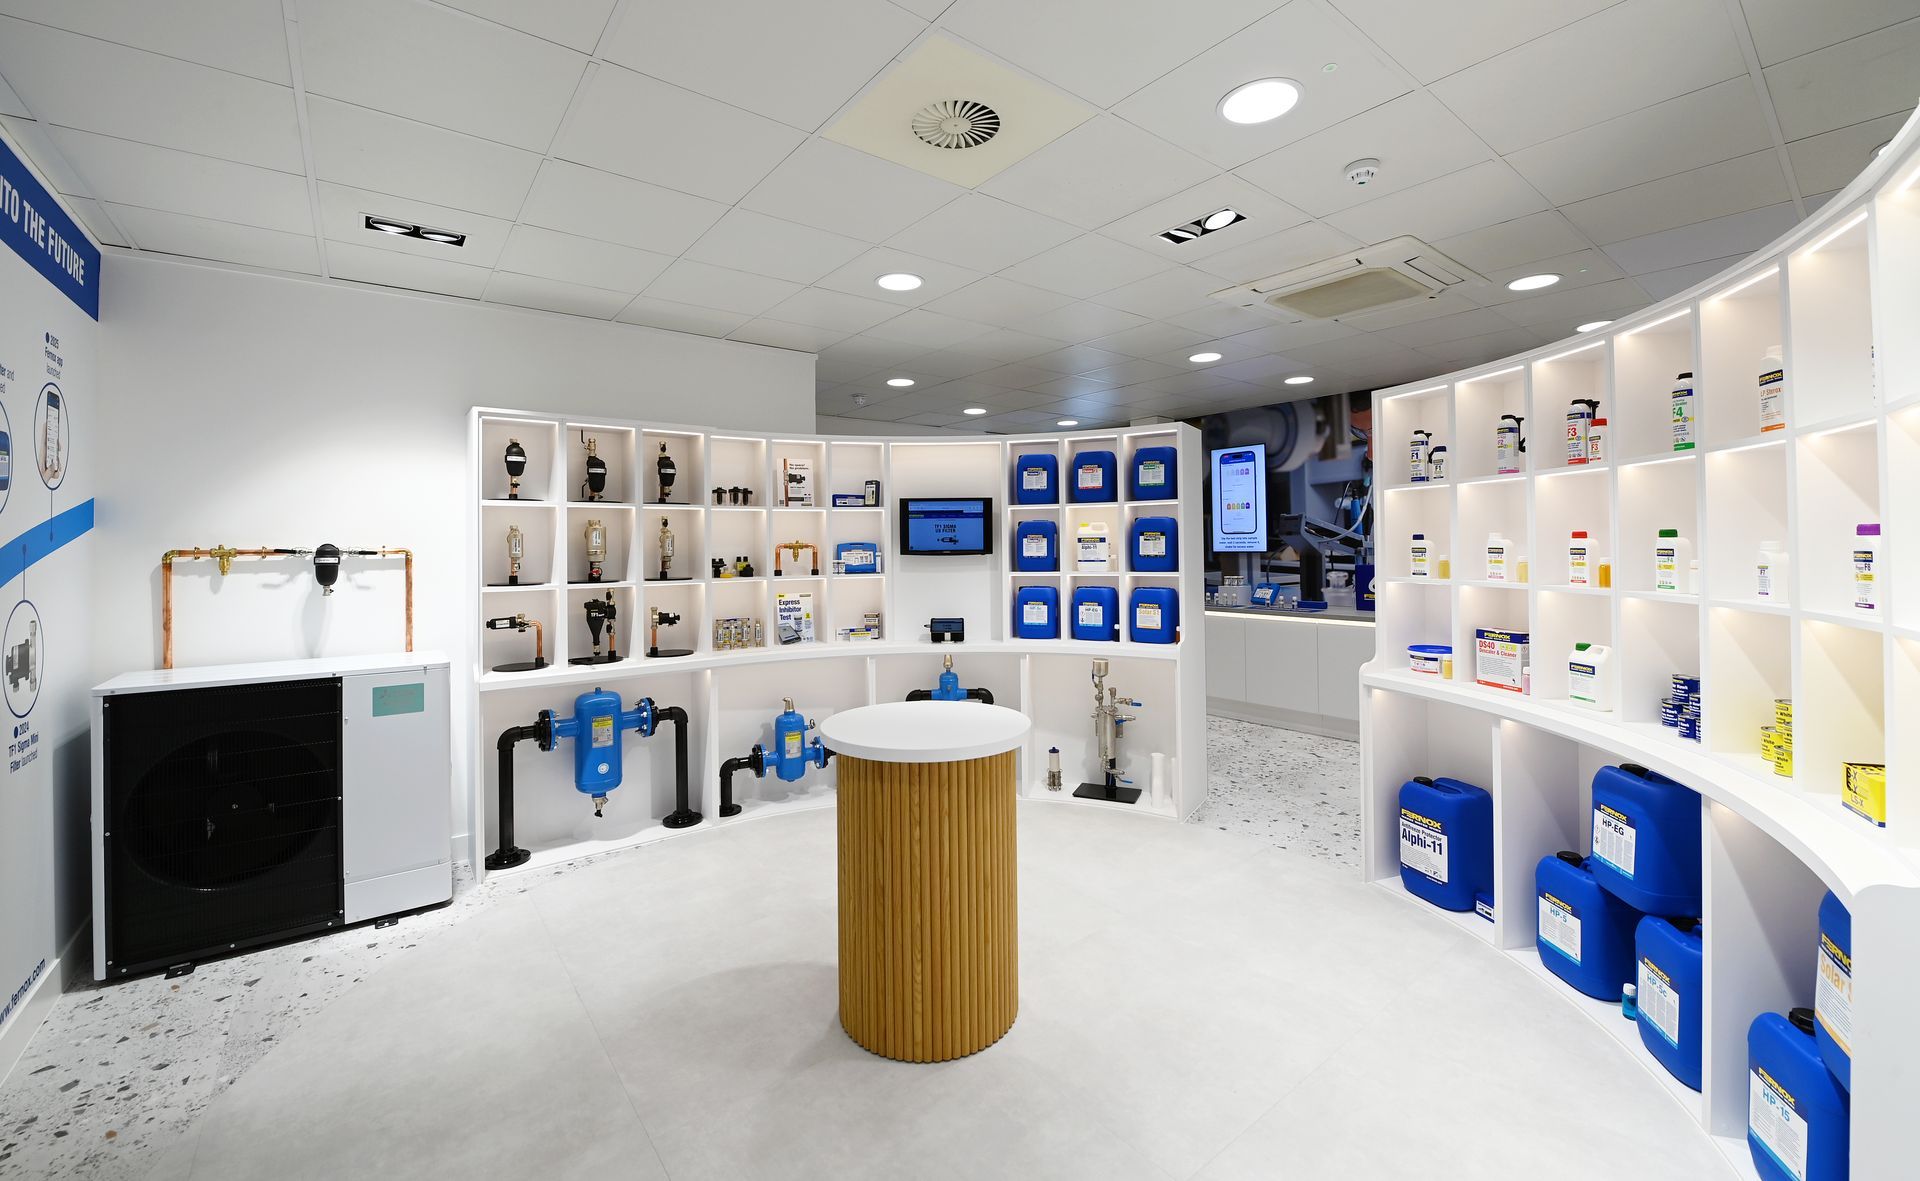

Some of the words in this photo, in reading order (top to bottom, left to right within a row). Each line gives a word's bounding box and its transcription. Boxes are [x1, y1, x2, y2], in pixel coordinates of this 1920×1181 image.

[23, 199, 46, 250] THE
[48, 226, 85, 287] FUTURE
[1567, 427, 1577, 437] F3
[1411, 452, 1419, 460] F1
[1478, 639, 1496, 650] DS40
[18, 720, 30, 736] 2024
[8, 742, 17, 759] TF1
[17, 737, 31, 754] Sigma
[30, 731, 39, 747] Mini
[10, 758, 21, 774] Filter
[21, 749, 38, 767] launched
[1401, 808, 1442, 830] FERNOX
[1401, 828, 1443, 855] Alphi-11
[1421, 829, 1442, 842] Protector
[1820, 953, 1846, 993] Solar
[1762, 1087, 1790, 1122] HP-15
